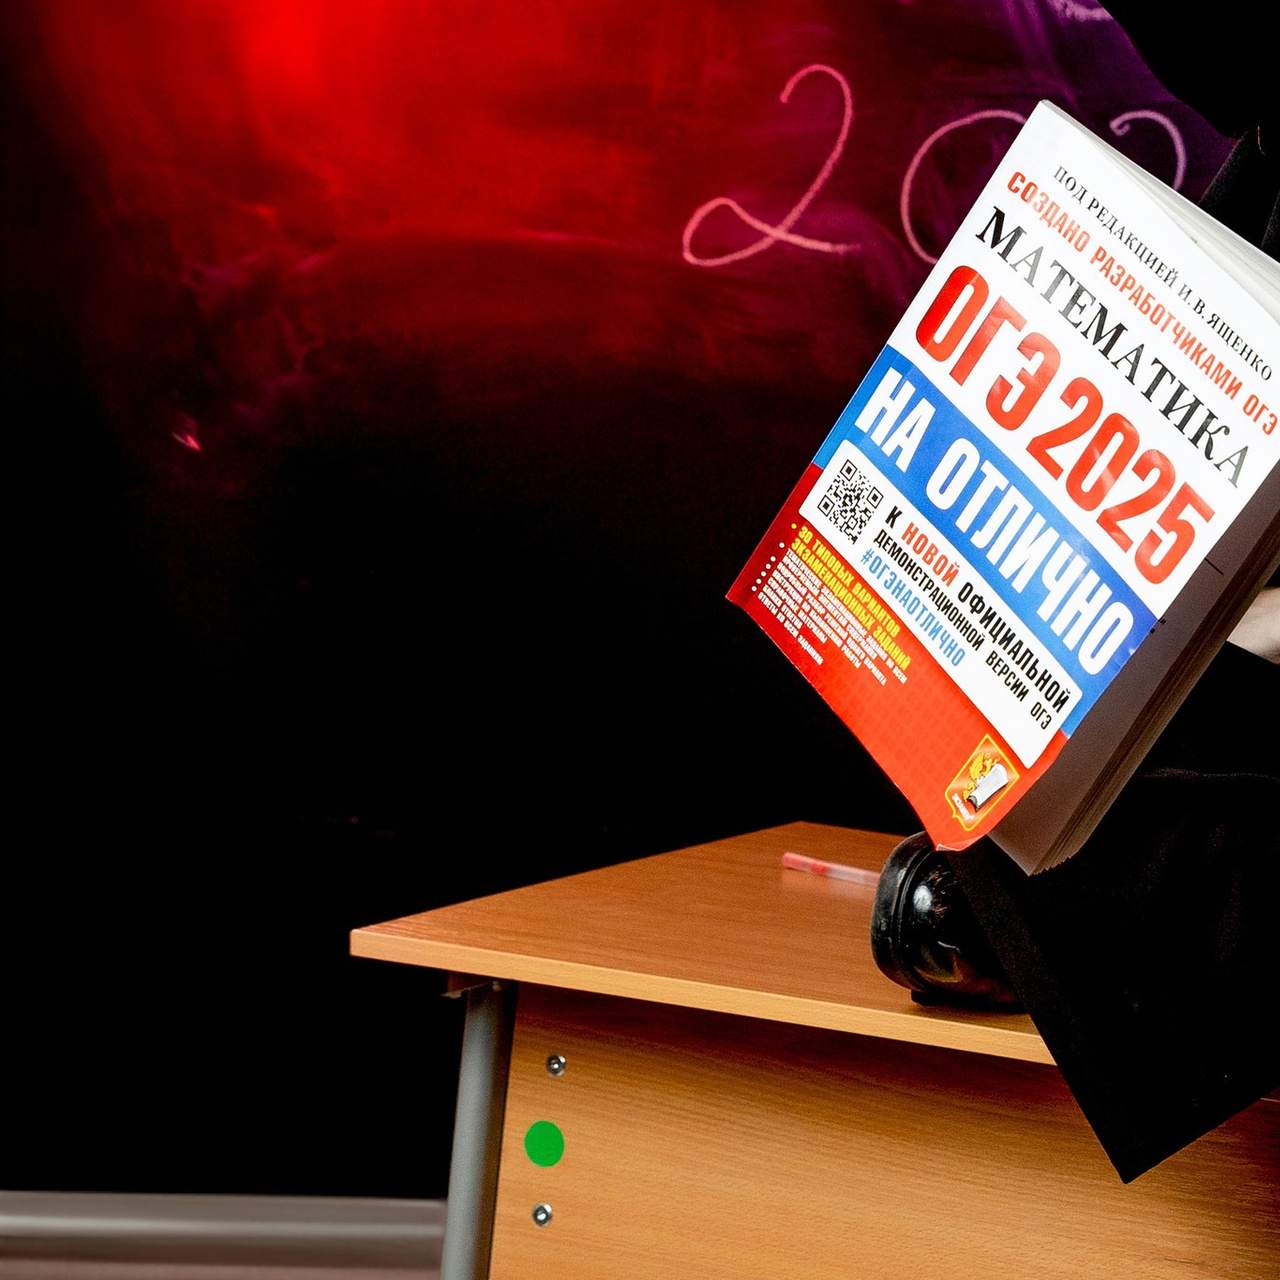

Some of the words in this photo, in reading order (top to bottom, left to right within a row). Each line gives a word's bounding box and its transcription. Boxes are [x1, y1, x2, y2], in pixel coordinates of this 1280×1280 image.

[974, 204, 1249, 488] МАТЕМАТИКА
[1005, 169, 1092, 254] СОЗДАНО
[1087, 247, 1244, 401] РАЗРАБОТЧИКАМИ
[1240, 393, 1280, 437] ОГЭ
[1052, 165, 1089, 206] ПОД
[1084, 196, 1183, 291] РЕДАКЦИЕЙ
[1203, 312, 1275, 383] ЯЩЕНКО
[854, 366, 938, 473] НА
[923, 439, 1136, 671] ОТЛИЧНО
[912, 269, 1060, 433] ОГЭ
[1024, 377, 1217, 581] 2025
[790, 537, 874, 629] ЭКЗАМЕНАЦИОННЫХ
[871, 626, 912, 670] ЗАДАНИЙ
[796, 525, 814, 543] 30
[810, 538, 854, 586] ТИПОВЫХ
[851, 582, 901, 637] ВАРИАНТОВ
[859, 546, 968, 667] #ОГЭНАОТЛИЧНО
[872, 529, 988, 651] ДЕМОНСТРАЦИОННОЙ
[984, 650, 1029, 702] ВЕРСИИ
[1028, 702, 1052, 730] ОГЭ
[885, 506, 903, 529] К
[900, 522, 963, 587] НОВОЙ
[957, 581, 1077, 714] ОФИЦИАЛЬНОЙ
